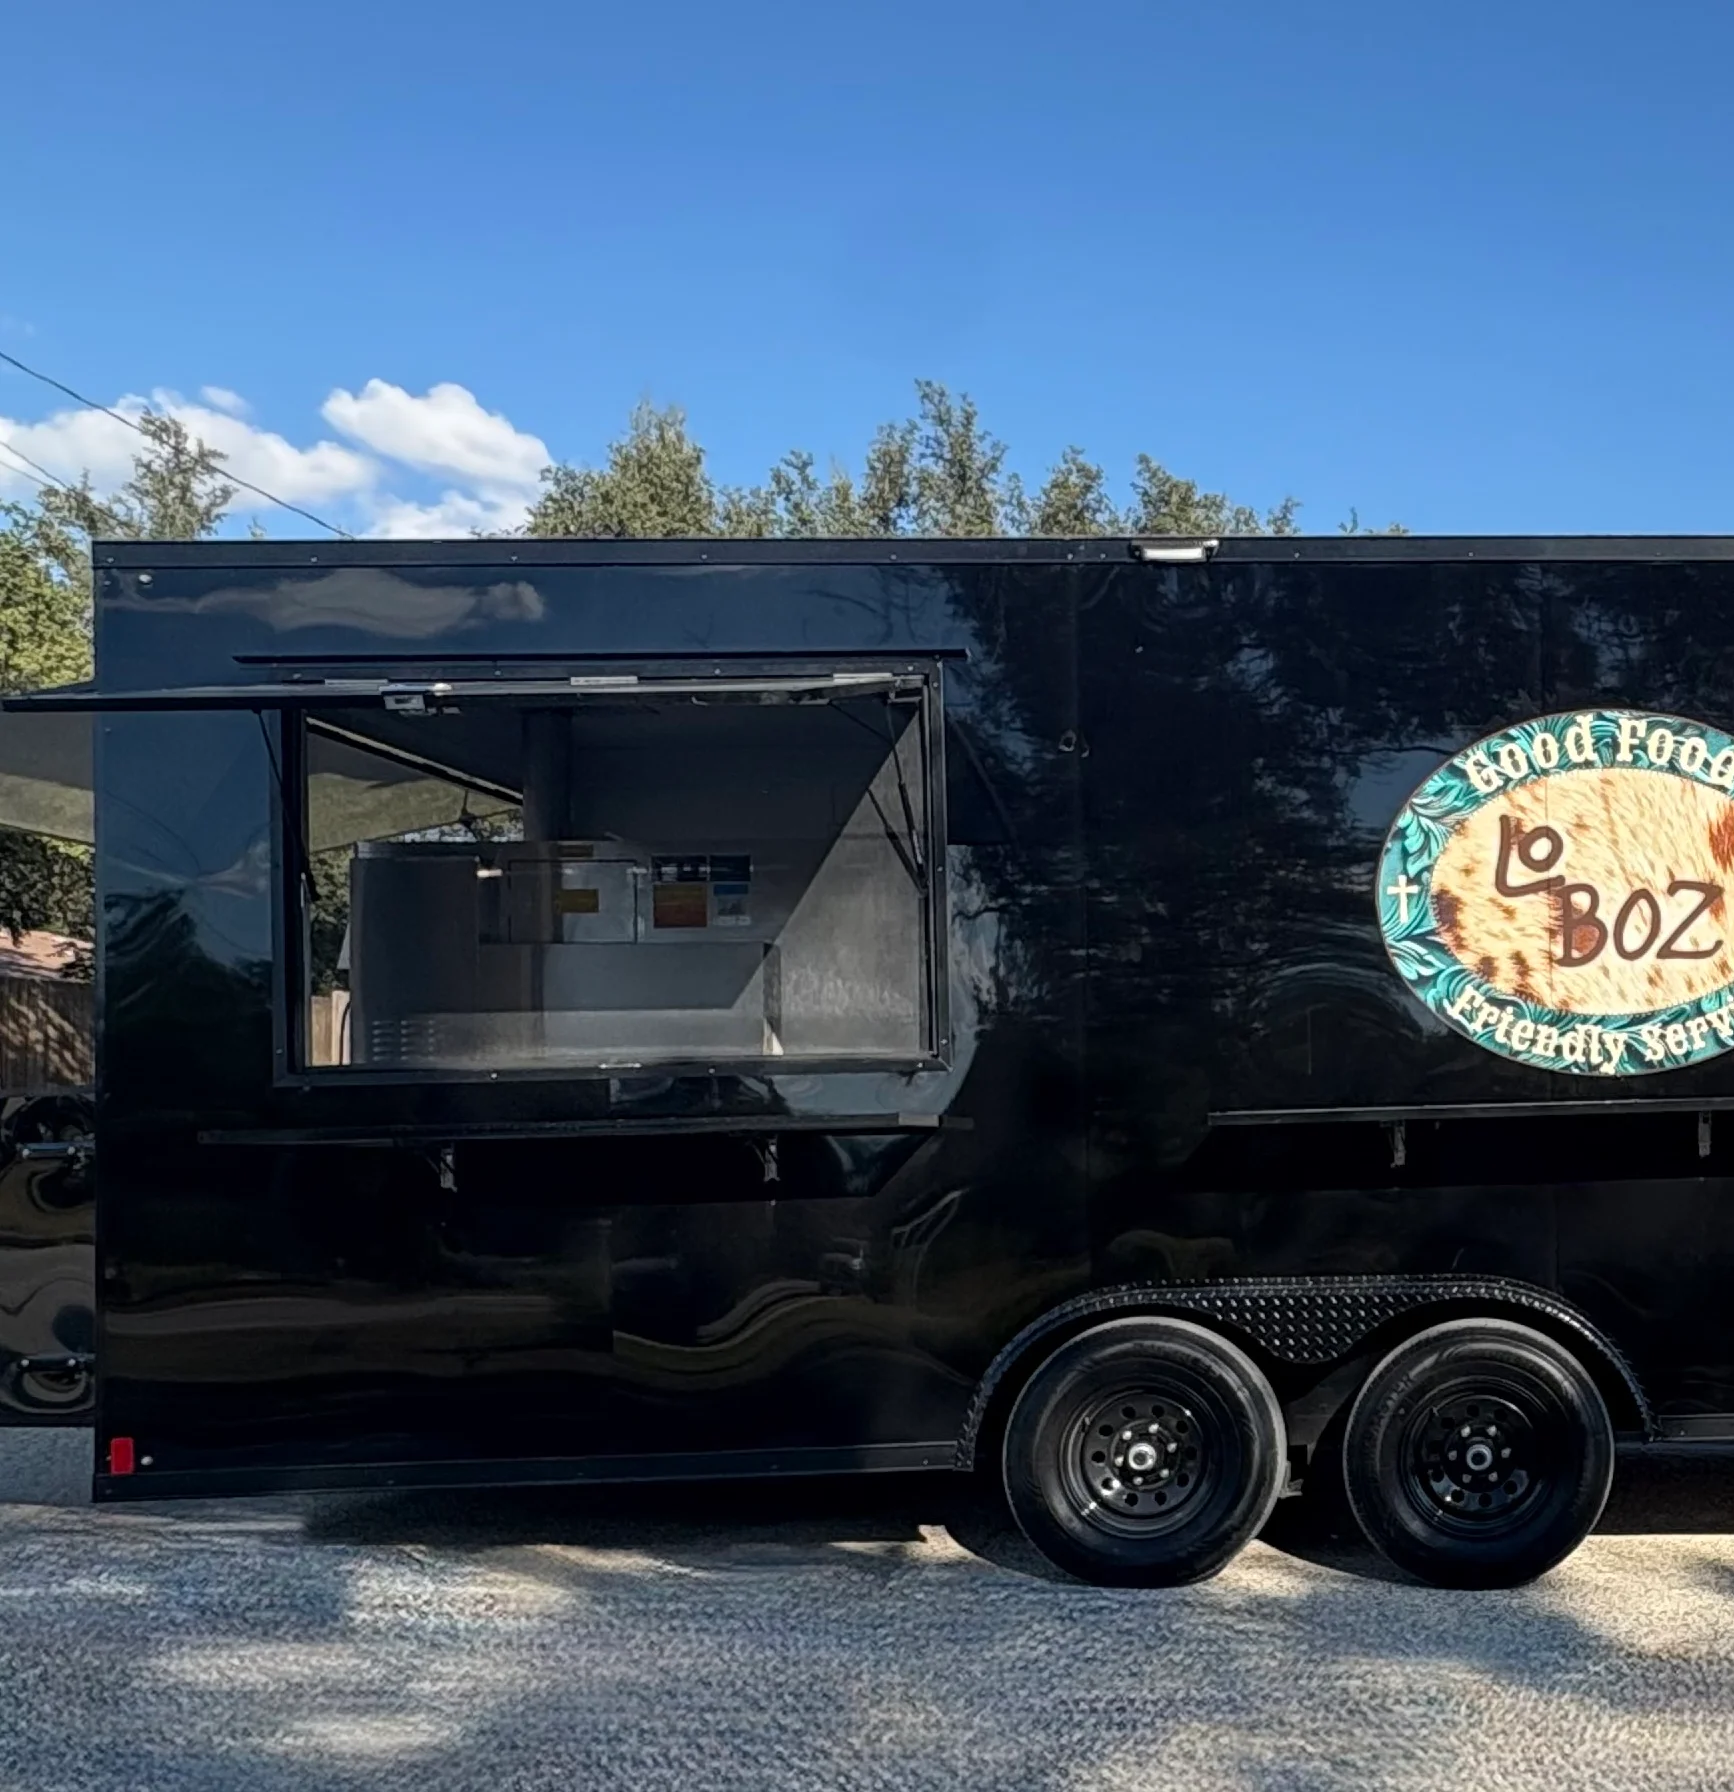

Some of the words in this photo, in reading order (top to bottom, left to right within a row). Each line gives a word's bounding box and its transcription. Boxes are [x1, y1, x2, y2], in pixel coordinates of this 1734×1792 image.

[1464, 714, 1598, 795] Good
[1553, 880, 1724, 968] BOZ
[1443, 986, 1630, 1075] Friendly
